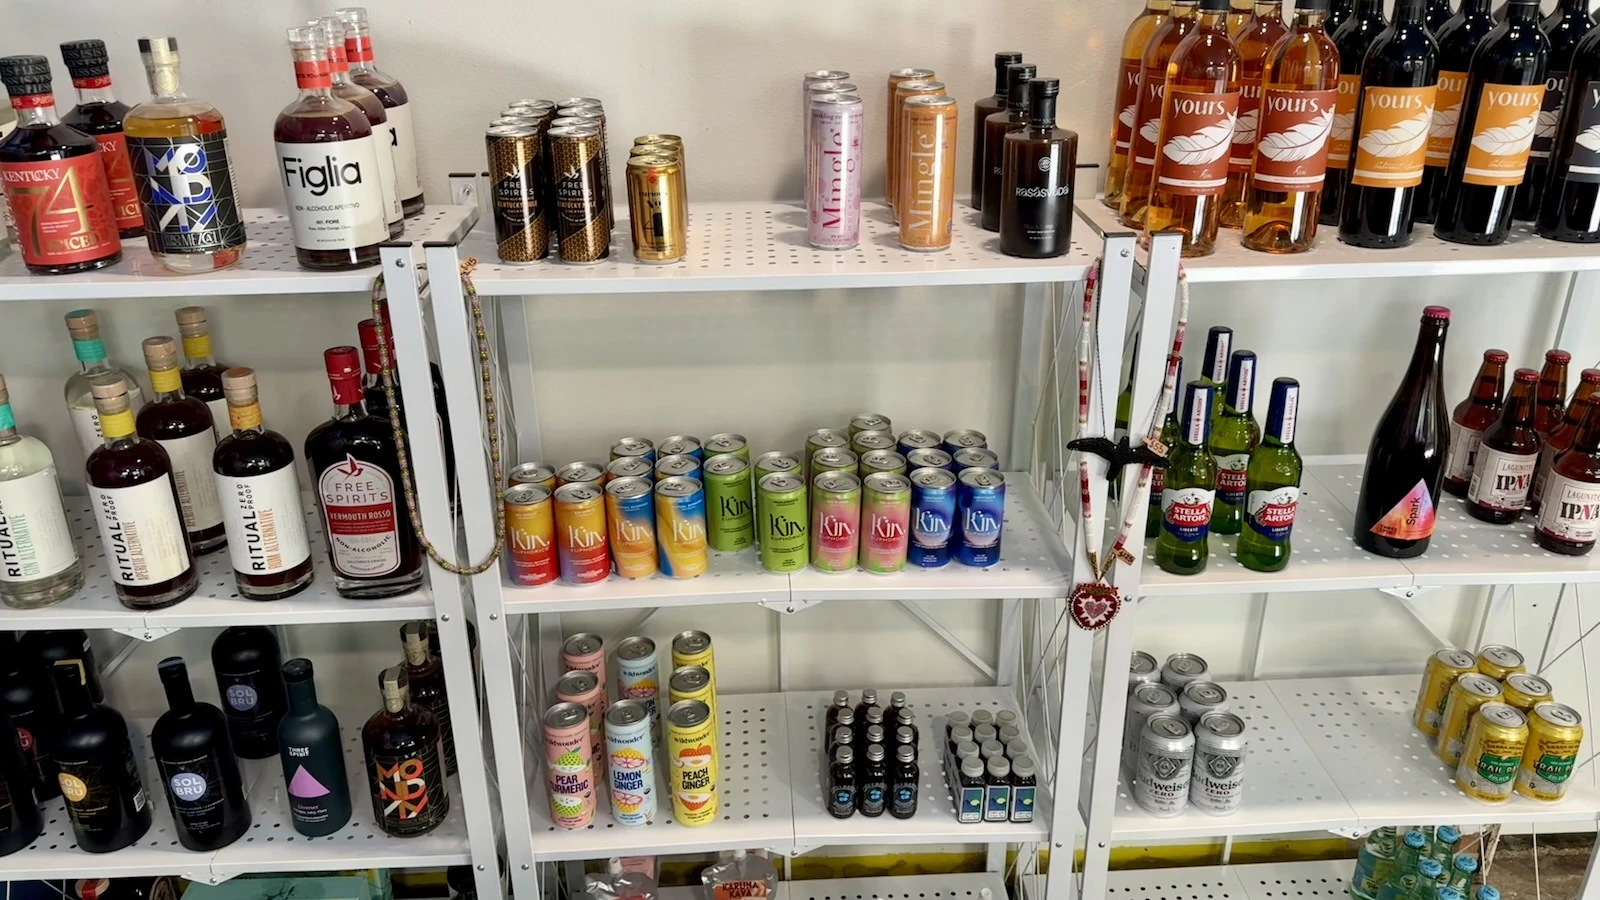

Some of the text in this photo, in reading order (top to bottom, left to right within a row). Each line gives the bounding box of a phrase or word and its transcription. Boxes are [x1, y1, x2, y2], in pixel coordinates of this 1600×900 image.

[1174, 98, 1225, 118] yours
[1267, 95, 1319, 115] yours
[1370, 93, 1423, 112] yours
[1488, 90, 1539, 111] yours
[2, 168, 60, 182] KENTUCKY
[282, 155, 362, 197] Figlia
[908, 133, 936, 231] Mingle
[499, 187, 535, 197] SPIRS
[335, 481, 374, 492] FREE
[1219, 479, 1246, 488] ARTO
[1495, 474, 1531, 491] IPNA
[236, 483, 247, 510] ZERO
[244, 484, 255, 510] PROOF
[326, 491, 389, 504] SPIRITS
[100, 494, 112, 520] ZERO
[106, 495, 119, 521] PROOF
[719, 495, 751, 517] Kin
[1174, 507, 1206, 516] STELLA
[1266, 507, 1296, 516] STELLA
[1406, 497, 1421, 526] Spark
[1560, 501, 1600, 520] IPNA
[329, 509, 391, 521] VERMOUTH ROSSO
[915, 507, 951, 533] Kin
[965, 507, 1001, 533] Kin
[1172, 514, 1207, 523] ARTOIS
[615, 518, 654, 541] Kin
[672, 519, 706, 542] Kin
[769, 513, 806, 537] Kin
[819, 511, 856, 537] Kin
[871, 513, 907, 538] Kin
[8, 512, 37, 561] ALTERNATIVE
[242, 510, 266, 571] RITUAL
[257, 507, 283, 570] RUM ALTERNATIVE
[510, 526, 551, 550] Kin
[568, 525, 606, 548] Kin
[108, 521, 135, 581] RITUAL
[622, 665, 656, 677] wildwonder
[229, 689, 253, 698] SOL
[231, 697, 254, 705] BRU
[673, 731, 710, 745] wildwonder
[682, 767, 709, 780] PEACH
[1475, 759, 1519, 774] TRAIL PA
[1533, 759, 1561, 774] TRAIL
[173, 776, 202, 787] SOL
[555, 774, 578, 785] PEAR
[613, 770, 642, 781] LEMON
[682, 777, 711, 790] GINGER
[176, 786, 203, 796] BRU
[613, 779, 644, 790] GINGER
[1149, 788, 1175, 797] ZERO
[1204, 787, 1230, 796] ZERO
[722, 881, 759, 891] KARUNA
[729, 889, 752, 898] KAVA
